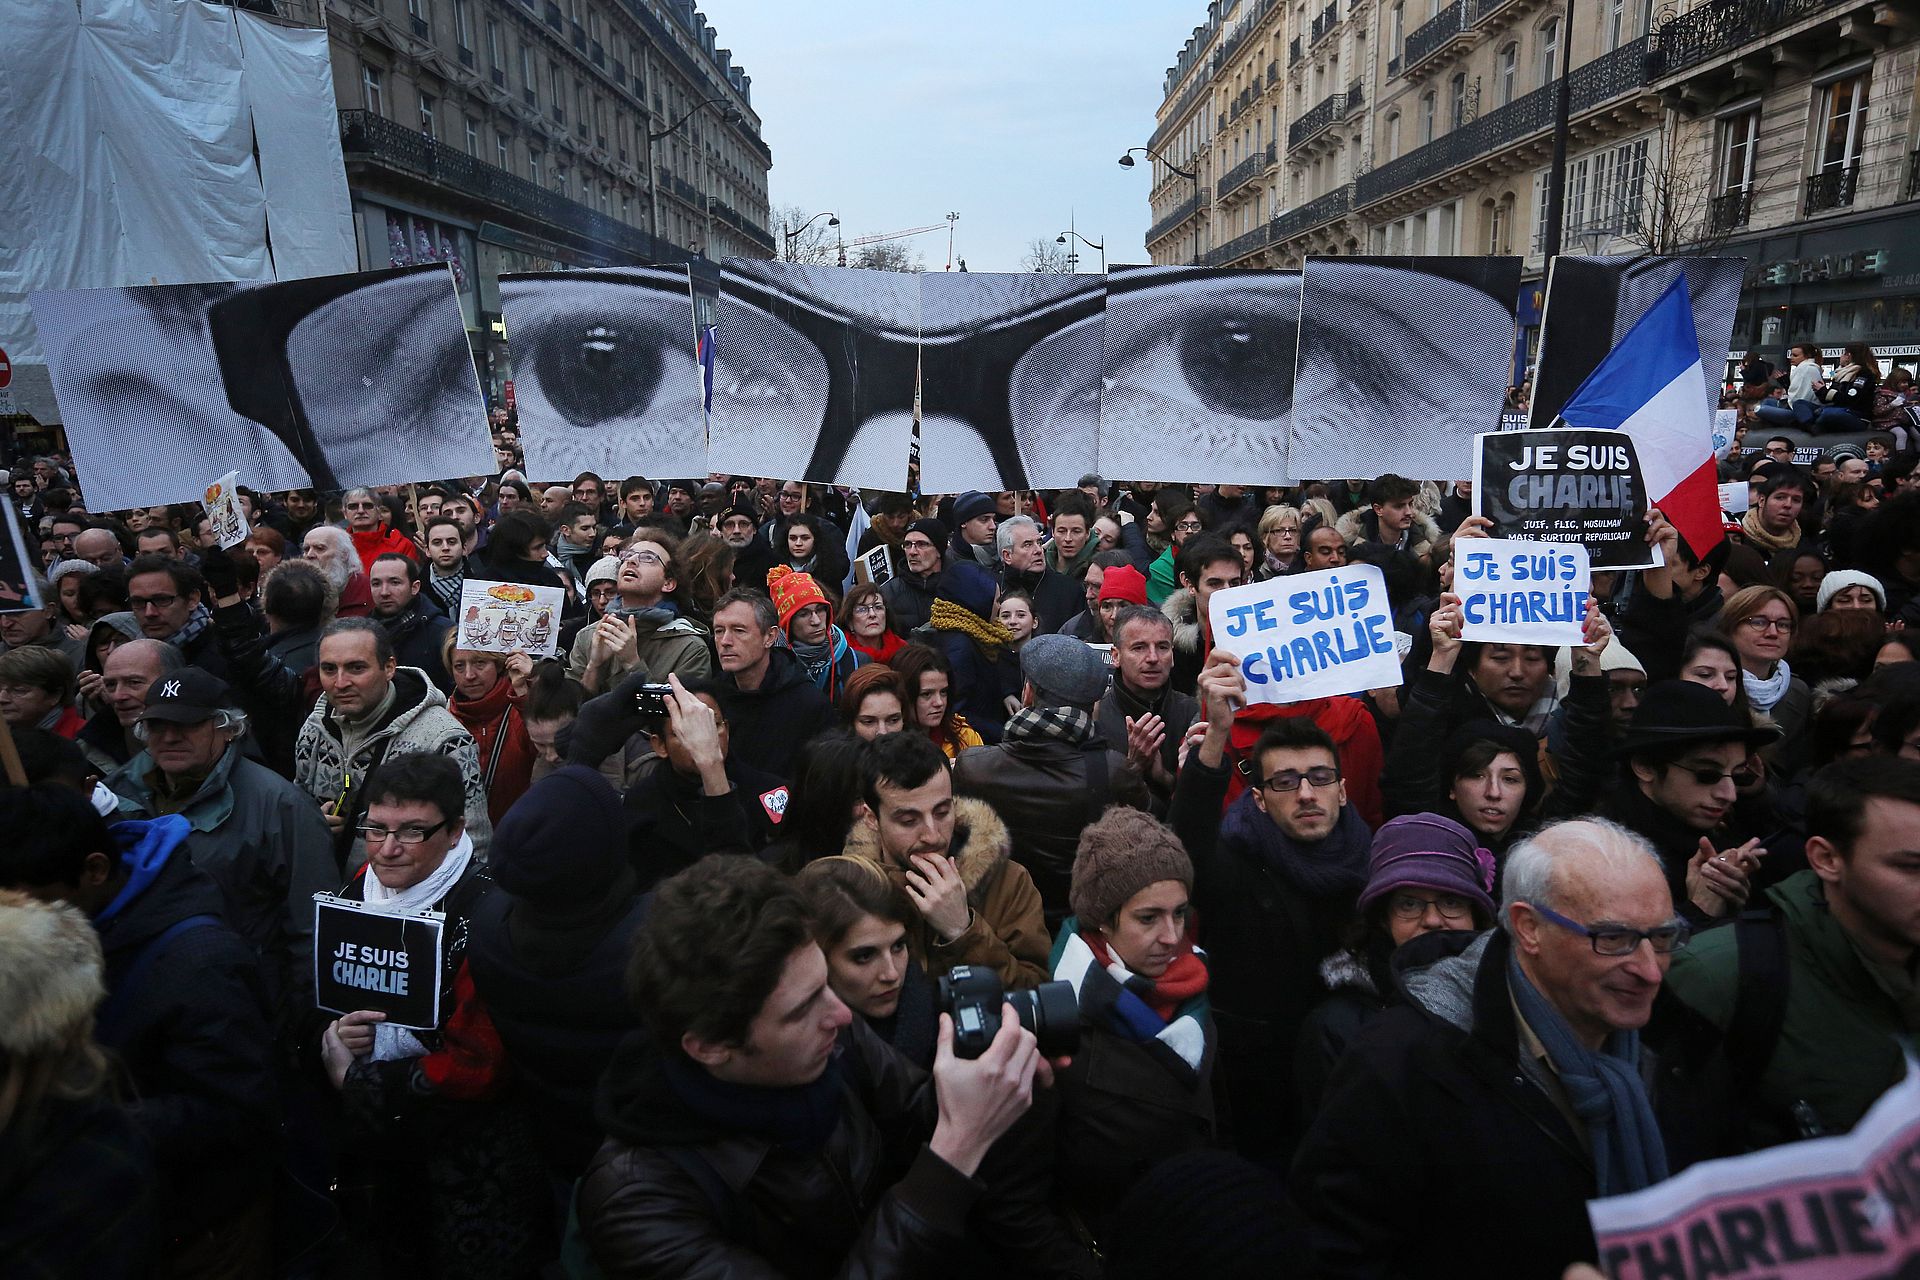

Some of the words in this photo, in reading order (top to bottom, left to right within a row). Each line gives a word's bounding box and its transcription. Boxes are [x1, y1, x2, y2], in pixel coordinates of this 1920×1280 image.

[1502, 414, 1528, 423] SUIS
[1508, 445, 1559, 471] JE
[1565, 445, 1631, 471] SUIS
[1796, 447, 1819, 455] SUIS
[1507, 474, 1634, 510] CHARLIE
[1508, 533, 1535, 542] MAIS
[1540, 533, 1581, 542] SURTOUT
[1226, 599, 1278, 637] JE
[333, 942, 357, 961] JE
[360, 946, 409, 969] SUIS
[332, 960, 409, 996] CHARLIE
